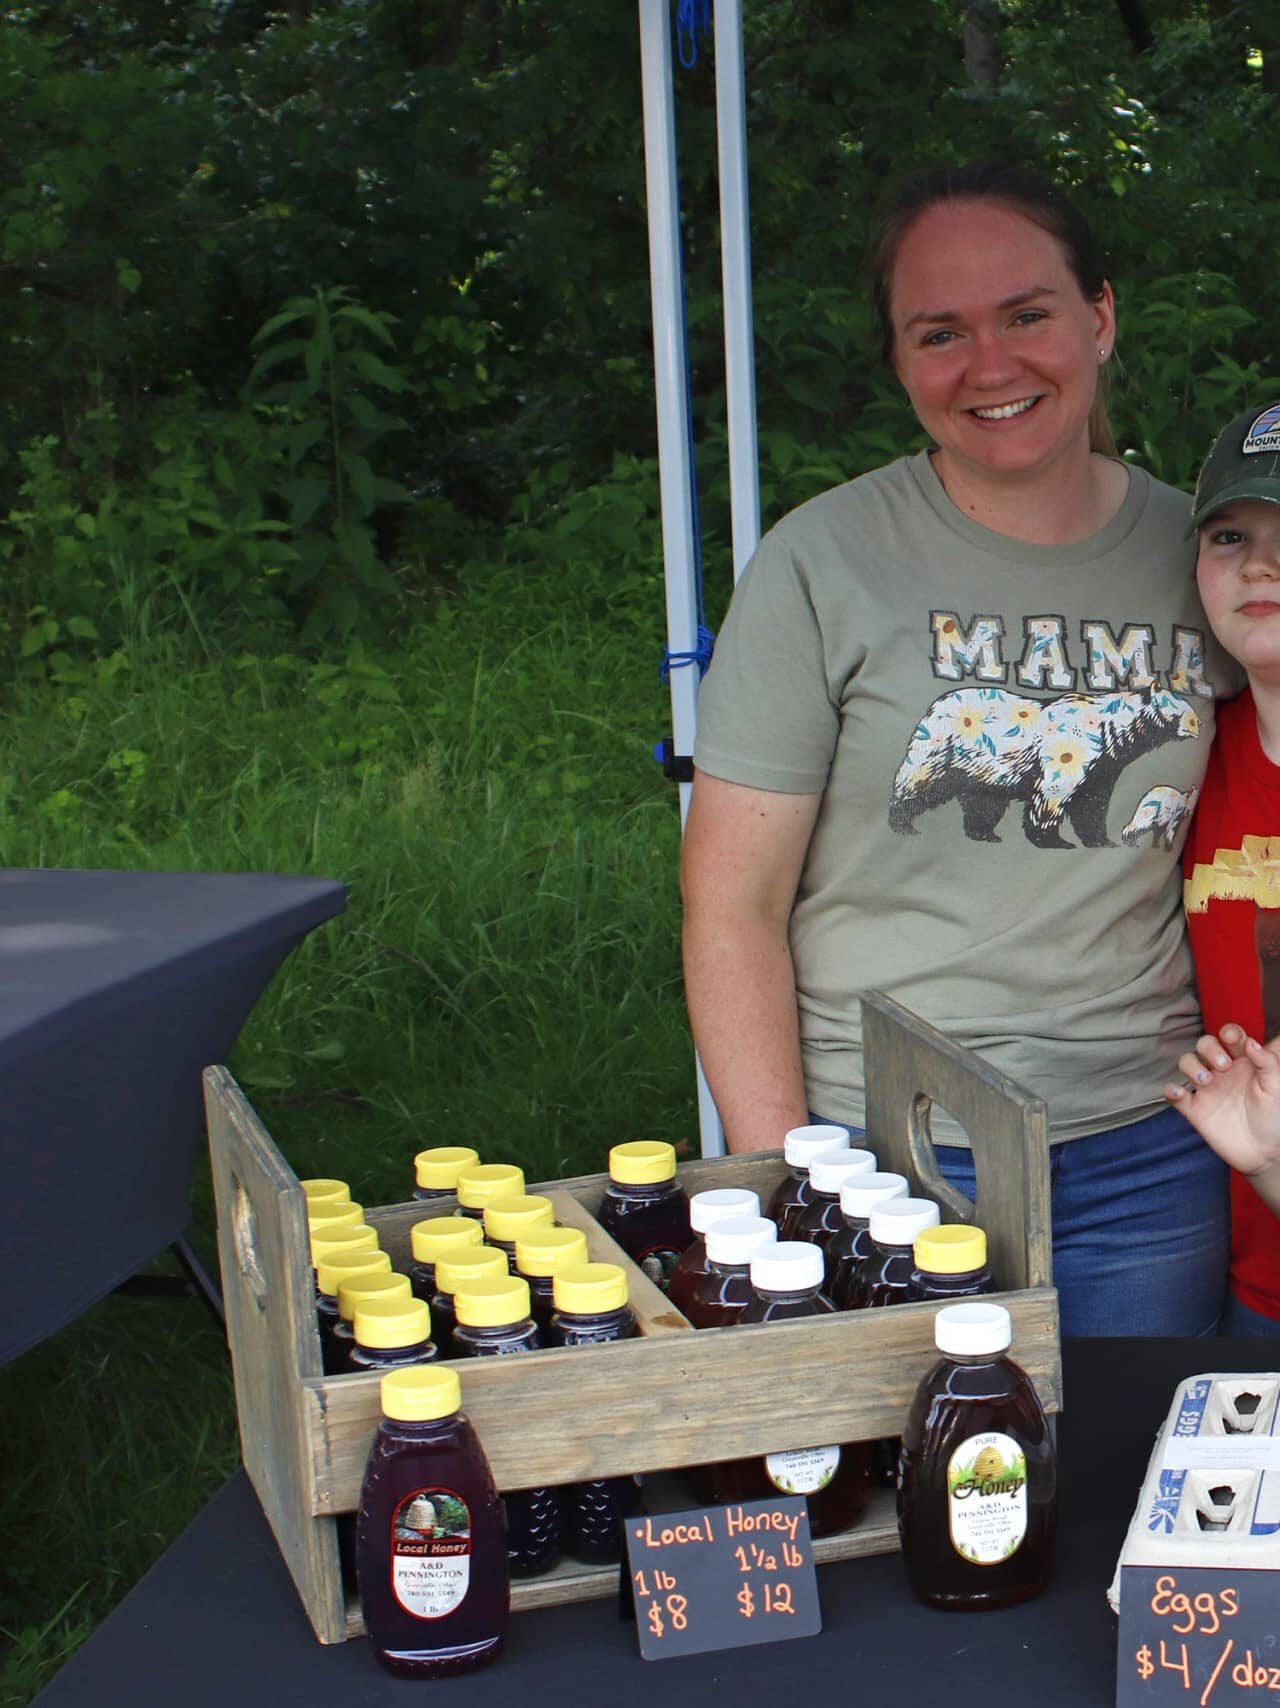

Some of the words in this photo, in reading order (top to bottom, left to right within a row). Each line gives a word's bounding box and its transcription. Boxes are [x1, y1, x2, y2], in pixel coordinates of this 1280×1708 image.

[929, 609, 1216, 698] MAMA
[975, 1436, 998, 1446] PURE
[953, 1477, 1025, 1500] Honey
[958, 1504, 1020, 1519] PENNINGTON
[646, 1515, 714, 1547] Local
[725, 1506, 798, 1541] Honey
[396, 1543, 428, 1553] Local
[431, 1543, 467, 1554] Honey
[781, 1541, 803, 1568] lb
[398, 1569, 464, 1579] PENNINGTON
[420, 1561, 444, 1570] A&D
[634, 1569, 651, 1596] 1
[653, 1568, 677, 1591] lb
[736, 1581, 796, 1619] $12
[1150, 1574, 1240, 1635] Eggs
[647, 1593, 689, 1638] $8
